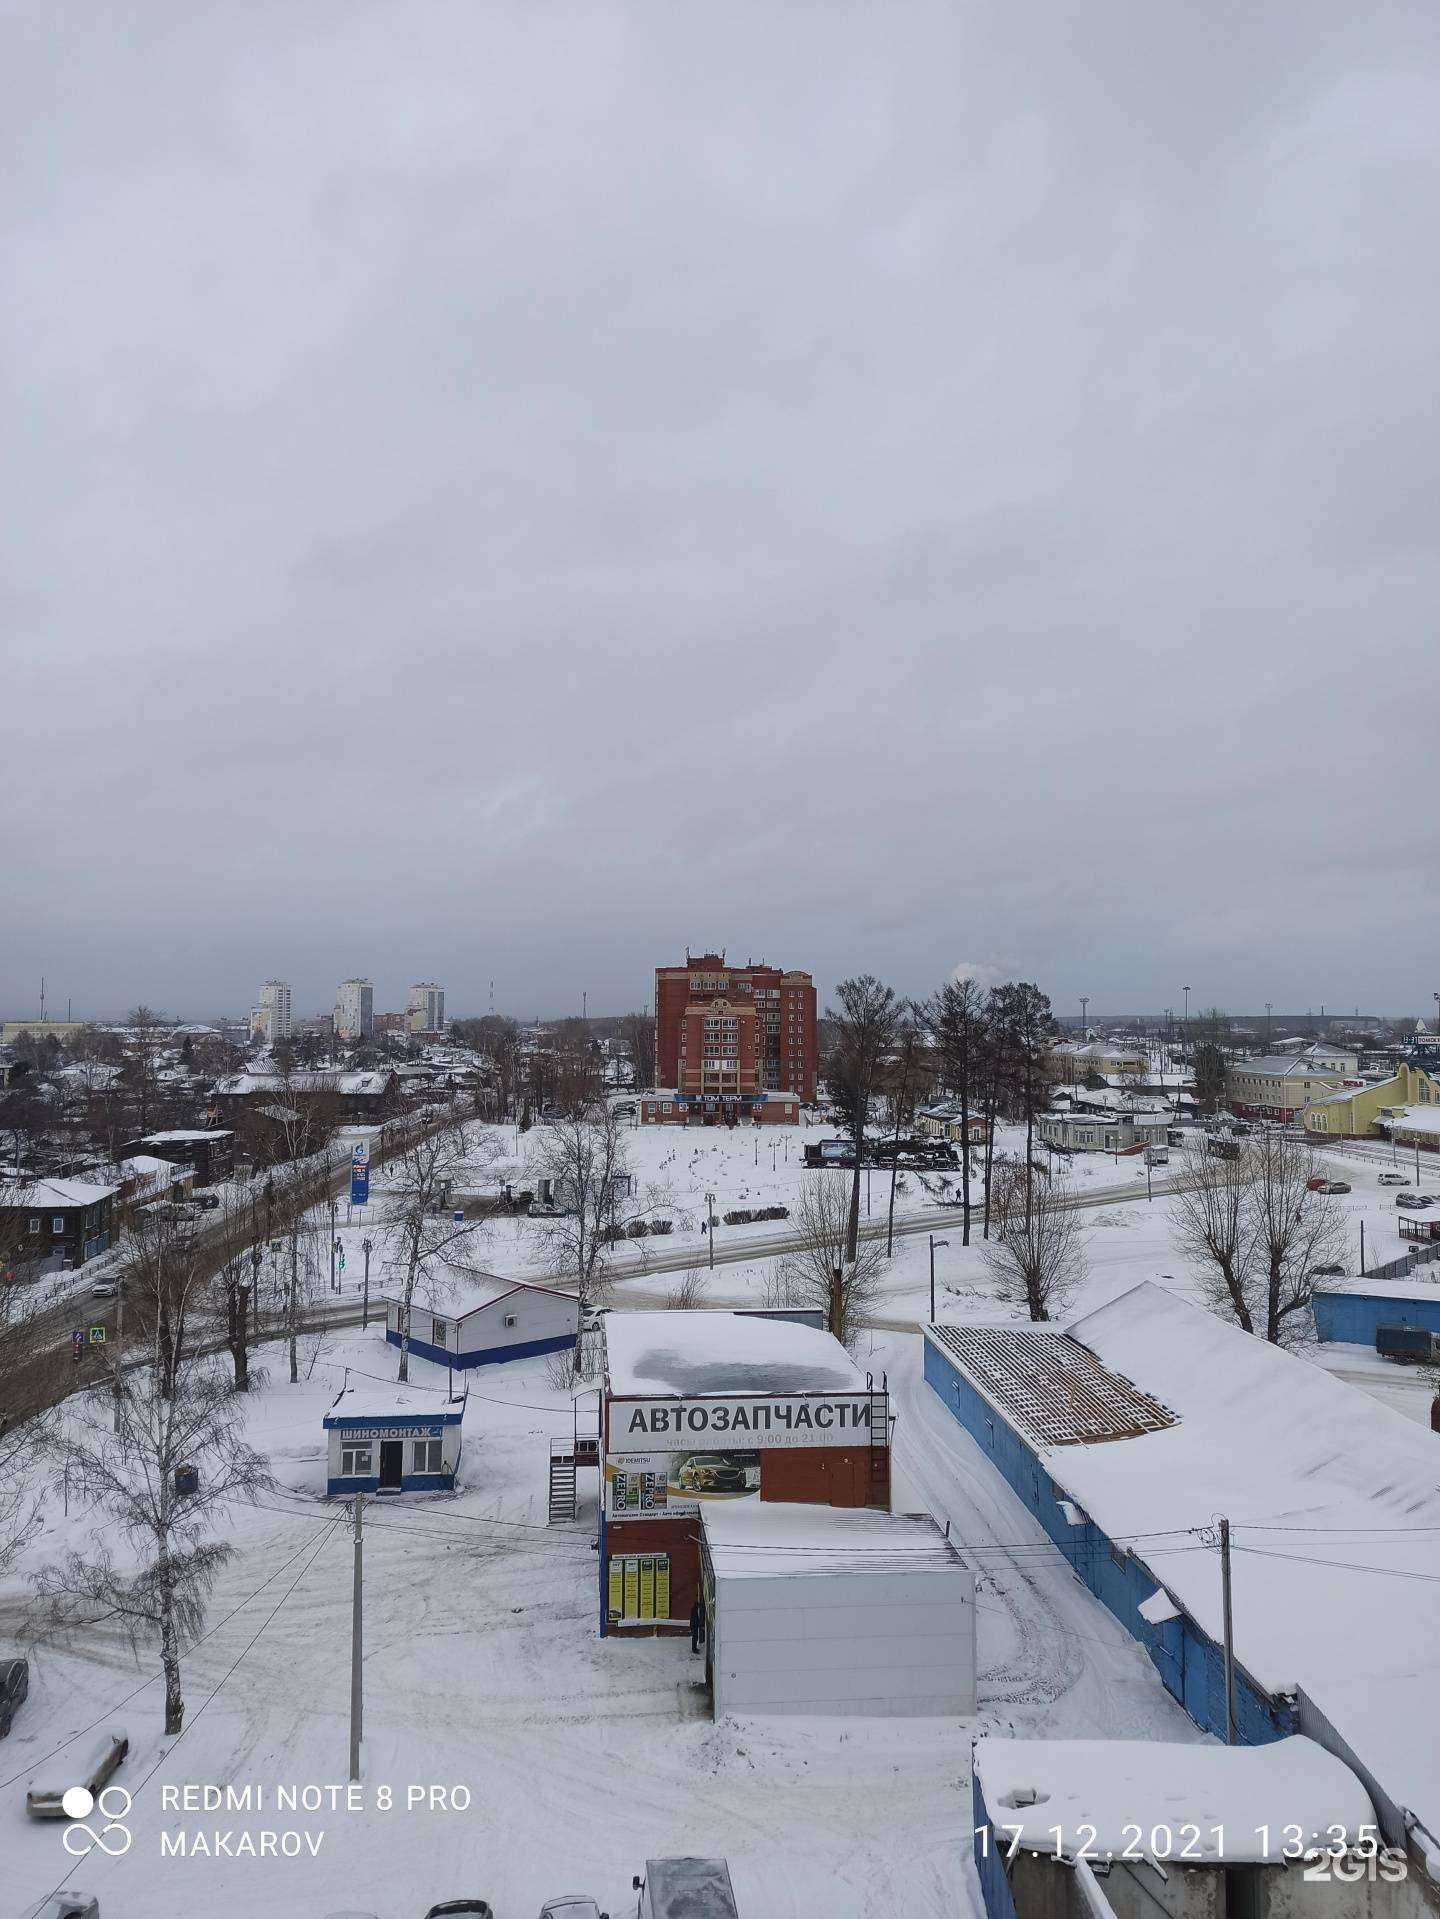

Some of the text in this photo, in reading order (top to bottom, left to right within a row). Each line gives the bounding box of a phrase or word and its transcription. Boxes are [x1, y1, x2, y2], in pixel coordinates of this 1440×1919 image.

[341, 1427, 431, 1440] ШИНОМОНТАЖ
[628, 1404, 871, 1433] АВТОЗАПЧАСТИ
[616, 1474, 626, 1510] ZEPRO
[645, 1473, 655, 1509] ZEPRO
